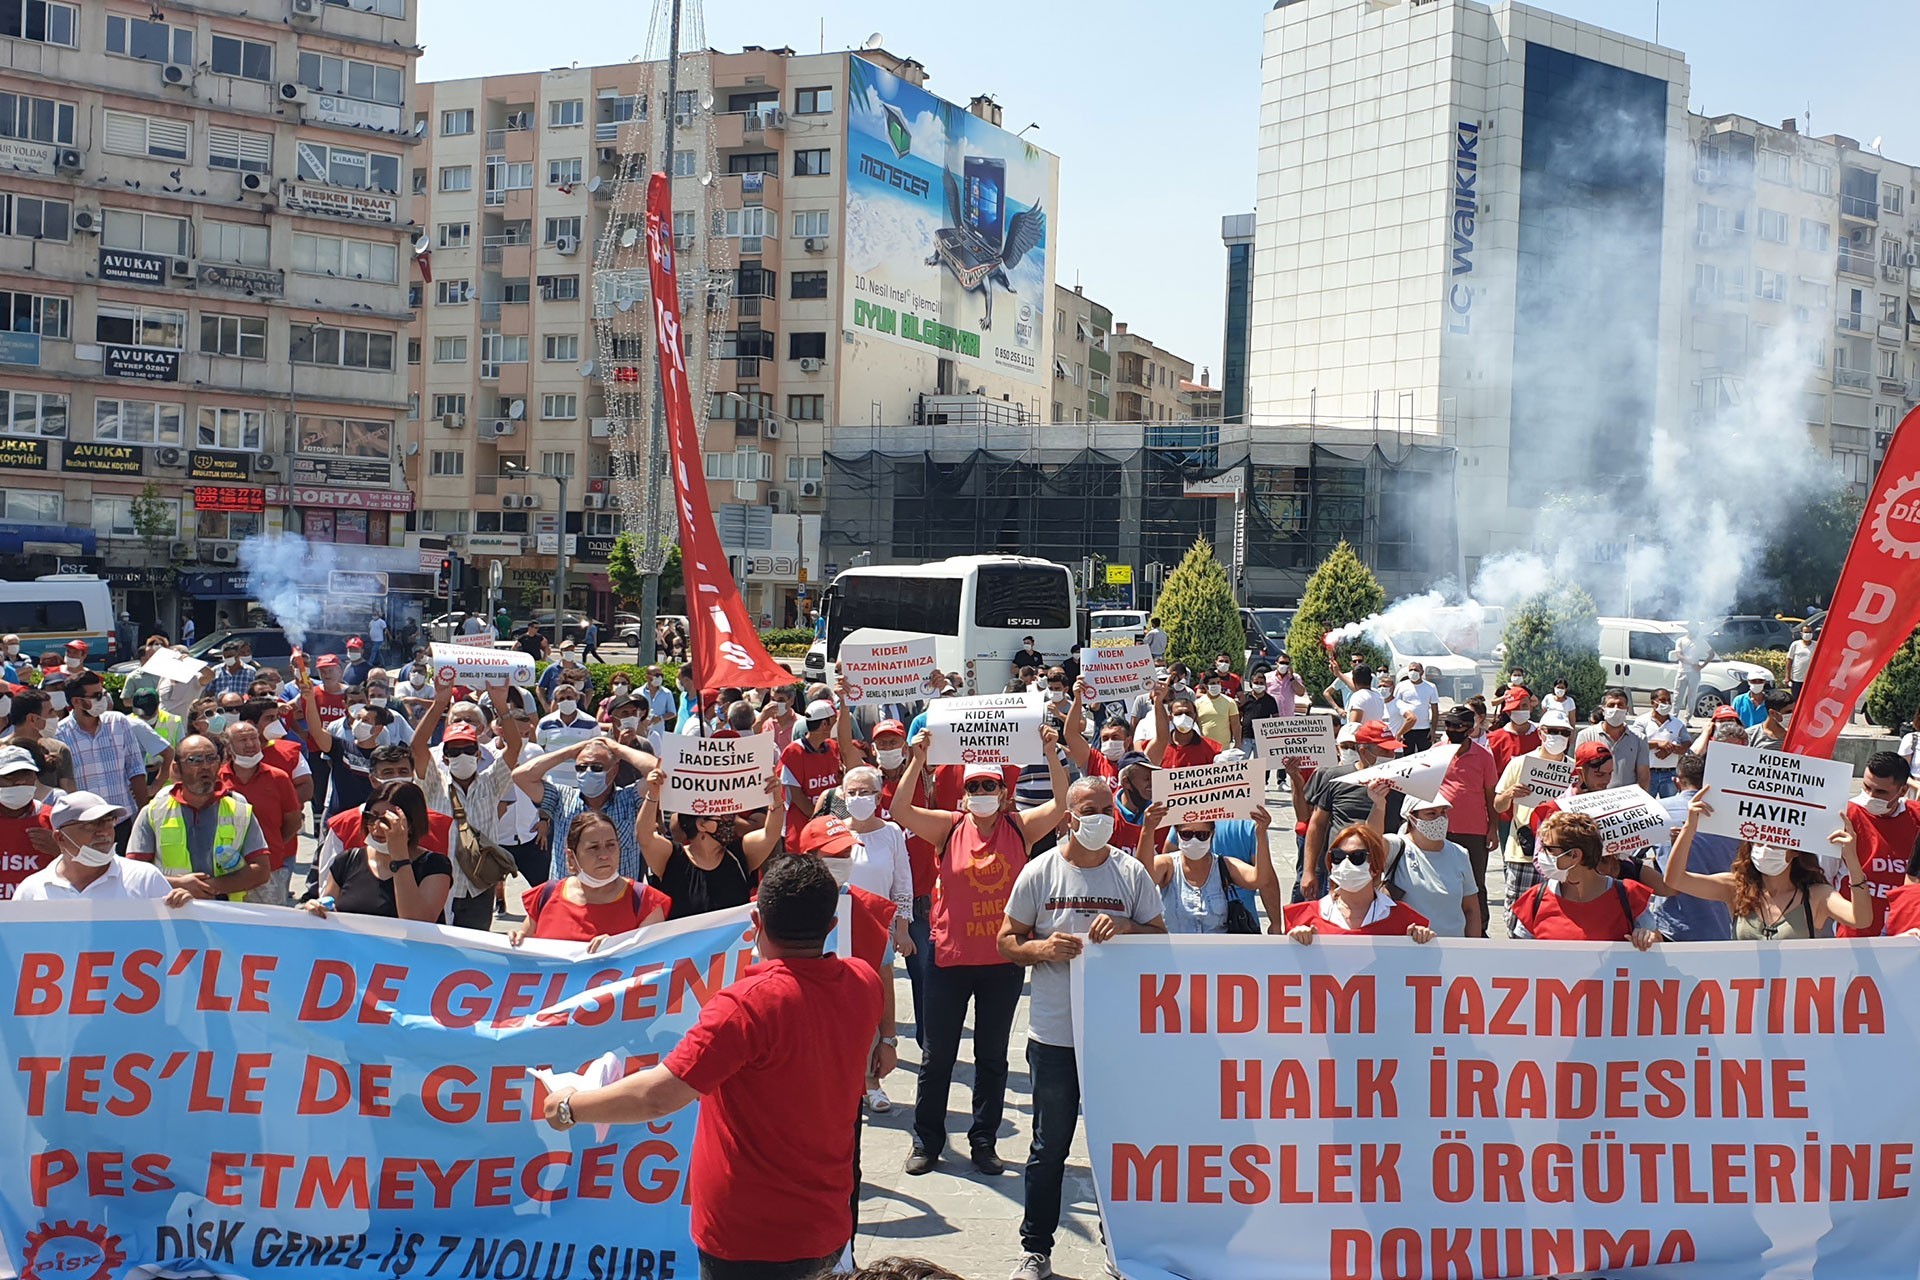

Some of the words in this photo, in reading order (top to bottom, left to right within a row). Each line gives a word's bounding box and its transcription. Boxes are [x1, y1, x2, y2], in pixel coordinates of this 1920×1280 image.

[13, 146, 48, 160] YOLDAŞ
[860, 153, 930, 200] MONSTER
[303, 189, 348, 204] MESKEN
[352, 195, 391, 209] İNŞAAT
[104, 256, 162, 271] AVUKAT
[106, 269, 128, 277] ONUR
[130, 271, 159, 280] MERSİN
[219, 277, 282, 292] MİMARLIK
[855, 275, 867, 291] 10.
[870, 280, 889, 298] Nesil
[1449, 283, 1472, 336] LC
[854, 298, 897, 336] OYUN
[901, 310, 981, 358] BİLGİSAYAR
[111, 350, 175, 364] AVUKAT
[995, 347, 1000, 357] 0
[113, 362, 144, 370] ZEYNEP
[73, 445, 133, 459] AVUKAT
[1007, 618, 1041, 626] ISUZU
[871, 645, 908, 657] KIDEM
[1097, 650, 1125, 659] KIDEM
[456, 657, 511, 666] DOKUMA
[846, 656, 935, 672] TAZMİNATIMIZA
[1081, 662, 1123, 672] TAZMİNATI
[1125, 658, 1151, 669] GASP
[862, 673, 920, 686] DOKUNMA
[1094, 673, 1139, 685] EDİLEMEZ
[320, 704, 347, 718] DİSK
[965, 710, 1006, 720] KIDEM
[949, 719, 1019, 733] TAZMİNATI
[1260, 728, 1269, 737] İŞ
[1269, 723, 1328, 736] GÜVENCEMİZDİR
[1261, 720, 1285, 729] KIDEM
[1286, 718, 1325, 728] TAZMİNATI
[698, 740, 736, 752] HALK
[959, 735, 1010, 747] HAKTIR!
[1284, 737, 1309, 746] GASP
[977, 749, 1001, 757] EMEK
[1269, 744, 1326, 756] ETTİRMEYİZ!
[679, 749, 755, 766] İRADESİNE
[977, 755, 1010, 764] PARTİSİ
[1759, 753, 1801, 770] KIDEM
[1169, 761, 1249, 782] DEMOKRATİK
[1730, 764, 1825, 788] TAZMİNATININ
[671, 772, 763, 792] DOKUNMA!
[809, 773, 838, 790] DİSK
[1173, 773, 1245, 792] HAKLARIMA
[1747, 781, 1805, 798] GASPINA
[709, 798, 735, 808] EMEK
[1166, 788, 1251, 809] DOKUNMA!
[709, 803, 744, 814] PARTİSİ
[1200, 807, 1225, 815] EMEK
[1738, 800, 1807, 827] HAYIR!
[1199, 812, 1235, 821] PARTİSİ
[1597, 815, 1623, 830] ENEL
[1622, 807, 1649, 823] GREV
[1620, 813, 1664, 838] DİRENİŞ
[1759, 825, 1791, 837] EMEK
[1619, 839, 1649, 851] PARTİSİ
[1620, 835, 1641, 845] EMEK
[1759, 833, 1801, 848] PARTİSİ
[0, 853, 39, 871] İSK
[974, 862, 1003, 876] EMEP
[1872, 854, 1909, 873] DİS
[297, 959, 410, 1025] DE
[1138, 973, 1376, 1034] KIDEM
[1405, 967, 1886, 1038] TAZMİNATINA
[296, 1054, 393, 1118] DE
[1220, 1058, 1399, 1120] HALK
[1429, 1046, 1809, 1120] İRADESİNE
[30, 1149, 176, 1208] PES
[205, 1120, 693, 1210] ETMEYECEĞ
[1110, 1142, 1402, 1204] MESLEK
[1432, 1130, 1914, 1204] ÖRGÜTLERİNE
[155, 1207, 246, 1264] DİSK
[425, 1236, 462, 1278] 7
[460, 1237, 576, 1280] NOLU
[1329, 1227, 1696, 1280] DOKUNMA
[34, 1251, 104, 1273] DİSK
